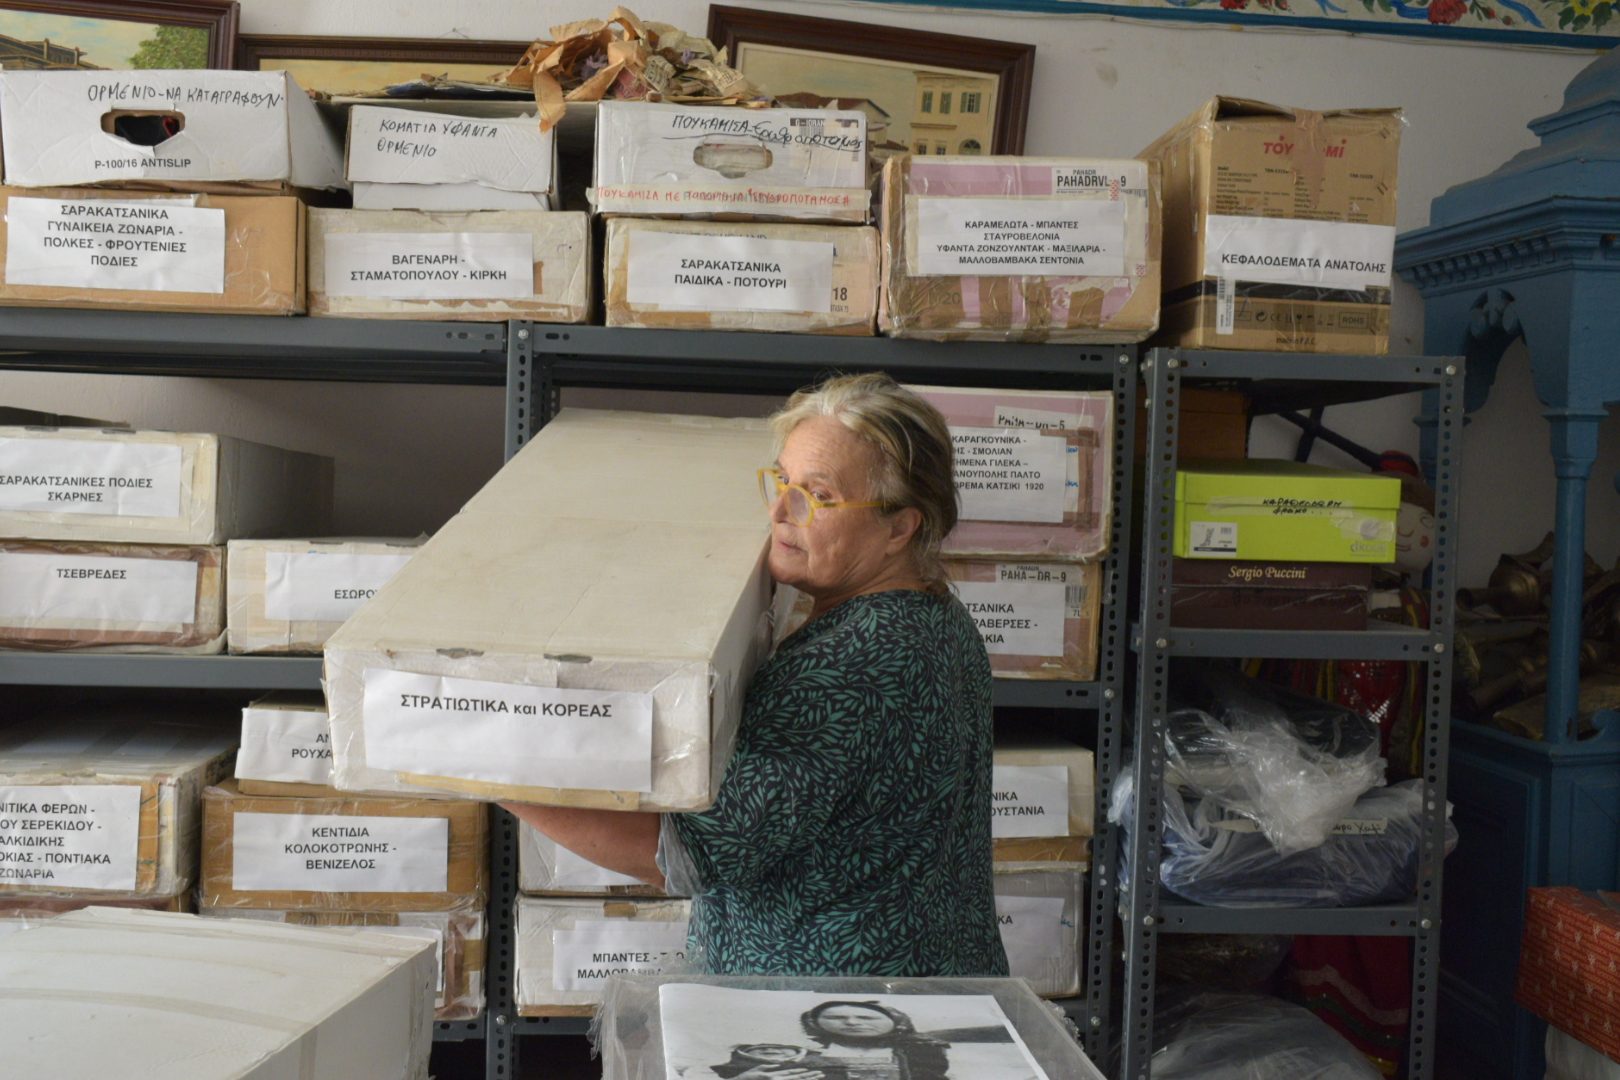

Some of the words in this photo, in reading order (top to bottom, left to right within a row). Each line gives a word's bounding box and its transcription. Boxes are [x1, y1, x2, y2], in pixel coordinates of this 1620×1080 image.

[94, 159, 138, 169] P-100/16
[140, 158, 192, 168] ANTISLIP
[61, 205, 169, 219] ΣΑΡΑΚΑΤΣΑΝΙΚΑ
[47, 221, 115, 234] ΓΥΝΑΙΚΕΙΑ
[117, 223, 177, 236] ΖΩΝΑΡΙΑ
[965, 220, 1028, 229] ΚΑΡΑΜΕΛΩΤΑ
[1036, 220, 1079, 229] ΜΠΑΝΤΕΣ
[983, 232, 1060, 241] ΣΤΑΥΡΟΒΕΛΟΝΙΑ
[44, 237, 94, 249] ΠΟΛΚΕΣ
[105, 239, 187, 253] ΦΡΟΥΤΕΝΙΕΣ
[937, 244, 975, 253] ΥΦΑΝΤΑ
[977, 244, 1044, 253] ΖΟΝΖΟΥΛΝΤΑΚ
[1052, 244, 1100, 253] ΜΑΞΙΛΑΡΙΑ
[90, 255, 138, 267] ΠΟΔΙΕΣ
[392, 255, 458, 265] ΒΑΓΕΝΑΡΗ
[959, 256, 1037, 264] ΜΑΛΛΟΒΑΜΒΑΚΑ
[1039, 256, 1084, 265] ΣΕΝΤΟΝΙΑ
[1222, 253, 1321, 269] ΚΕΦΑΛΟΔΕΜΑΤΑ
[1324, 258, 1387, 274] ΑΝΑΤΟΛΗΣ
[681, 259, 781, 273] ΣΑΡΑΚΑΤΣΑΝΙΚΑ
[350, 270, 459, 281] ΣΤΑΜΑΤΟΠΟΥΛΟΥ
[470, 270, 507, 280] ΚΙΡΚΗ
[674, 274, 723, 286] ΠΑΙΔΙΚΑ
[733, 277, 787, 289] ΠΟΤΟΥΡΙ
[972, 448, 1013, 456] ΣΜΟΛΙΑΝ
[989, 459, 1021, 467] ΓΙΛΕΚΑ
[1010, 471, 1041, 479] ΠΑΛΤΟ
[0, 475, 105, 487] ΣΑΡΑΚΑΤΣΑΝΙΚΕΣ
[108, 478, 153, 488] ΠΟΔΙΕΣ
[986, 482, 1020, 490] ΚΑΤΣΙΚΙ
[47, 491, 103, 502] ΣΚΑΡΝΕΣ
[57, 568, 127, 579] ΤΣΕΒΡΕΔΕΣ
[1228, 565, 1262, 581] Sergio
[1265, 566, 1307, 579] Puccini
[400, 694, 509, 714] ΣΤΡΑΤΙΩΤΙΚΑ
[513, 704, 537, 716] και
[542, 703, 612, 718] ΚΟΡΕΑΣ
[41, 804, 88, 814] ΦΕΡΩΝ
[21, 820, 94, 831] ΣΕΡΕΚΙΔΟΥ
[312, 827, 369, 837] ΚΕΝΤΙΔΙΑ
[284, 843, 389, 854] ΚΟΛΟΚΟΤΡΩΝΗΣ
[45, 853, 111, 864] ΠΟΝΤΙΑΚΑ
[306, 859, 375, 869] ΒΕΝΙΖΕΛΟΣ
[592, 953, 650, 963] ΜΠΑΝΤΕΣ
